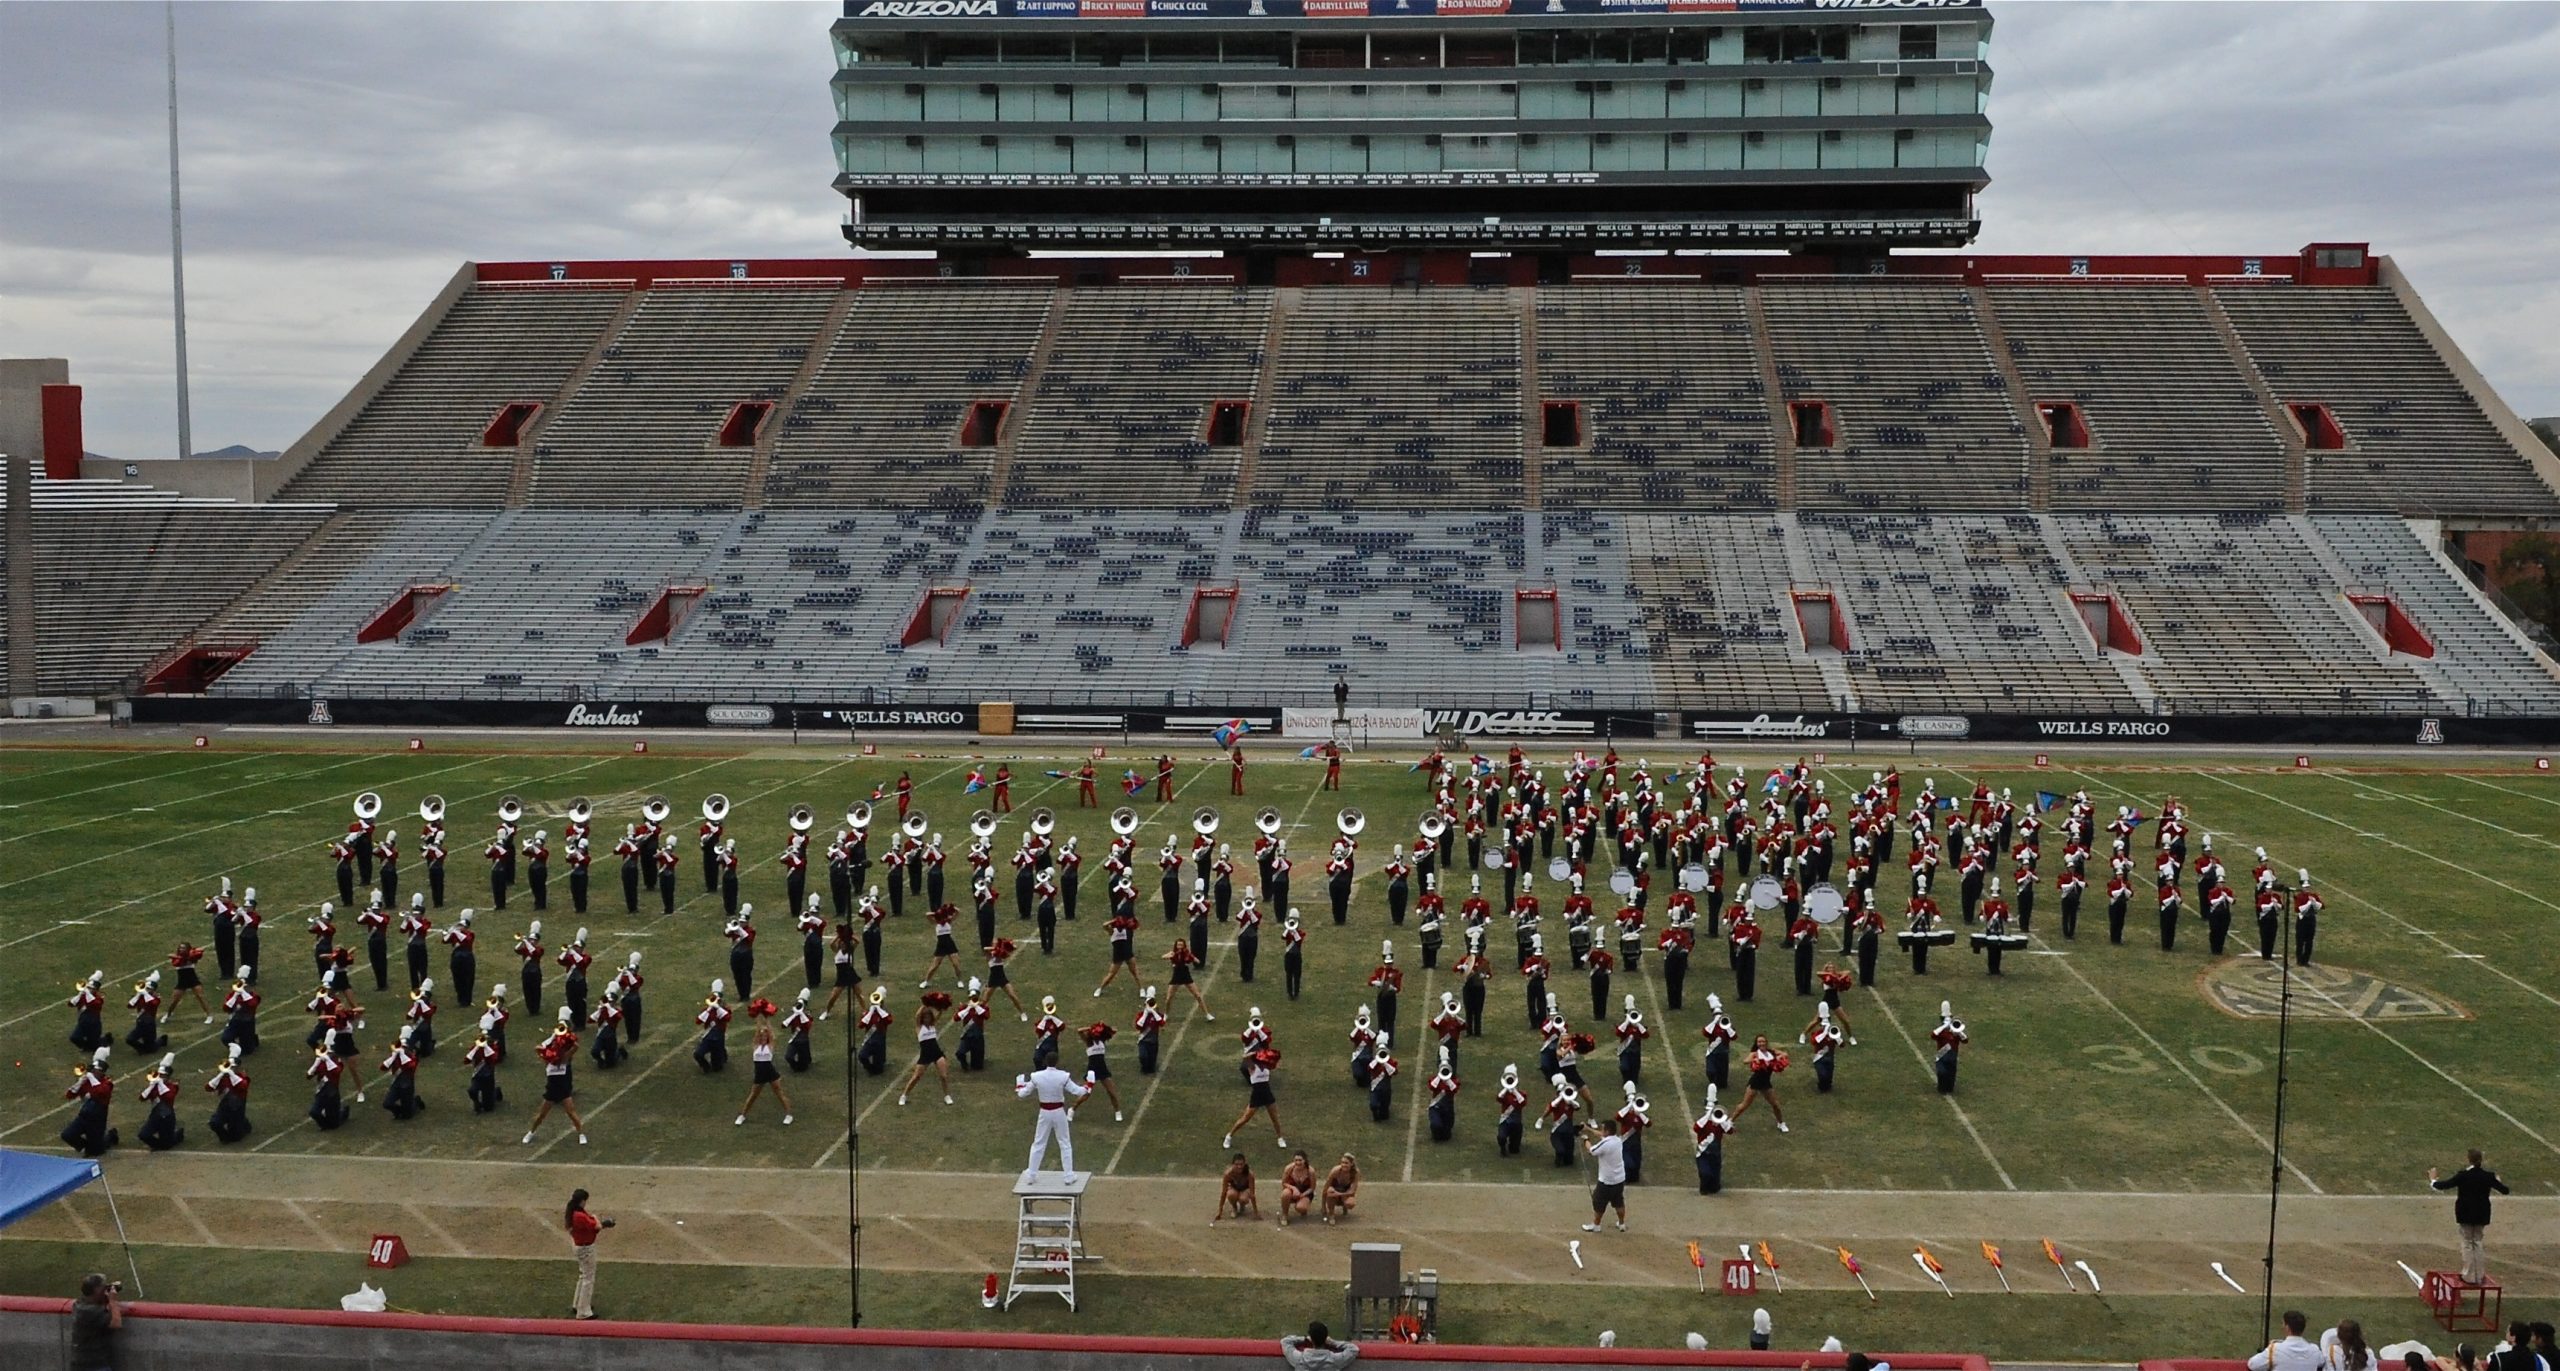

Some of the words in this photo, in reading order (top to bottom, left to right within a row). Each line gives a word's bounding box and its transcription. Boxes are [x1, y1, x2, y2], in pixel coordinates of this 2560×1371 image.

[859, 1, 998, 16] ARIZONA
[1016, 1, 1026, 10] 22
[1026, 2, 1041, 10] ART
[1043, 2, 1076, 10] LUPPINO
[1091, 2, 1113, 10] RICKY
[1152, 1, 1157, 10] 6
[1303, 2, 1309, 10] 4
[732, 269, 745, 278] 18
[940, 267, 952, 276] 19
[1174, 266, 1189, 276] 20
[1354, 265, 1367, 275] 21
[1626, 265, 1640, 275] 22
[1871, 264, 1886, 274] 23
[2072, 265, 2087, 275] 24
[2245, 265, 2260, 275] 25
[553, 270, 564, 280] 17
[126, 465, 137, 474] 16
[565, 704, 642, 726] Bashas'
[713, 710, 729, 718] SOL
[731, 710, 768, 718] CASINOS
[839, 711, 900, 724] WELLS
[905, 711, 963, 724] FARGO
[1286, 717, 1327, 728] UNIVERSITY
[1380, 717, 1401, 728] BAND
[1403, 717, 1419, 728] DAY
[1924, 721, 1962, 730] CASINOS
[2038, 722, 2103, 735] WELLS
[2108, 722, 2170, 735] FARGO
[2082, 1044, 2264, 1076] 30
[371, 1240, 392, 1263] 40
[1047, 1253, 1064, 1272] 50
[1727, 1266, 1749, 1289] 40
